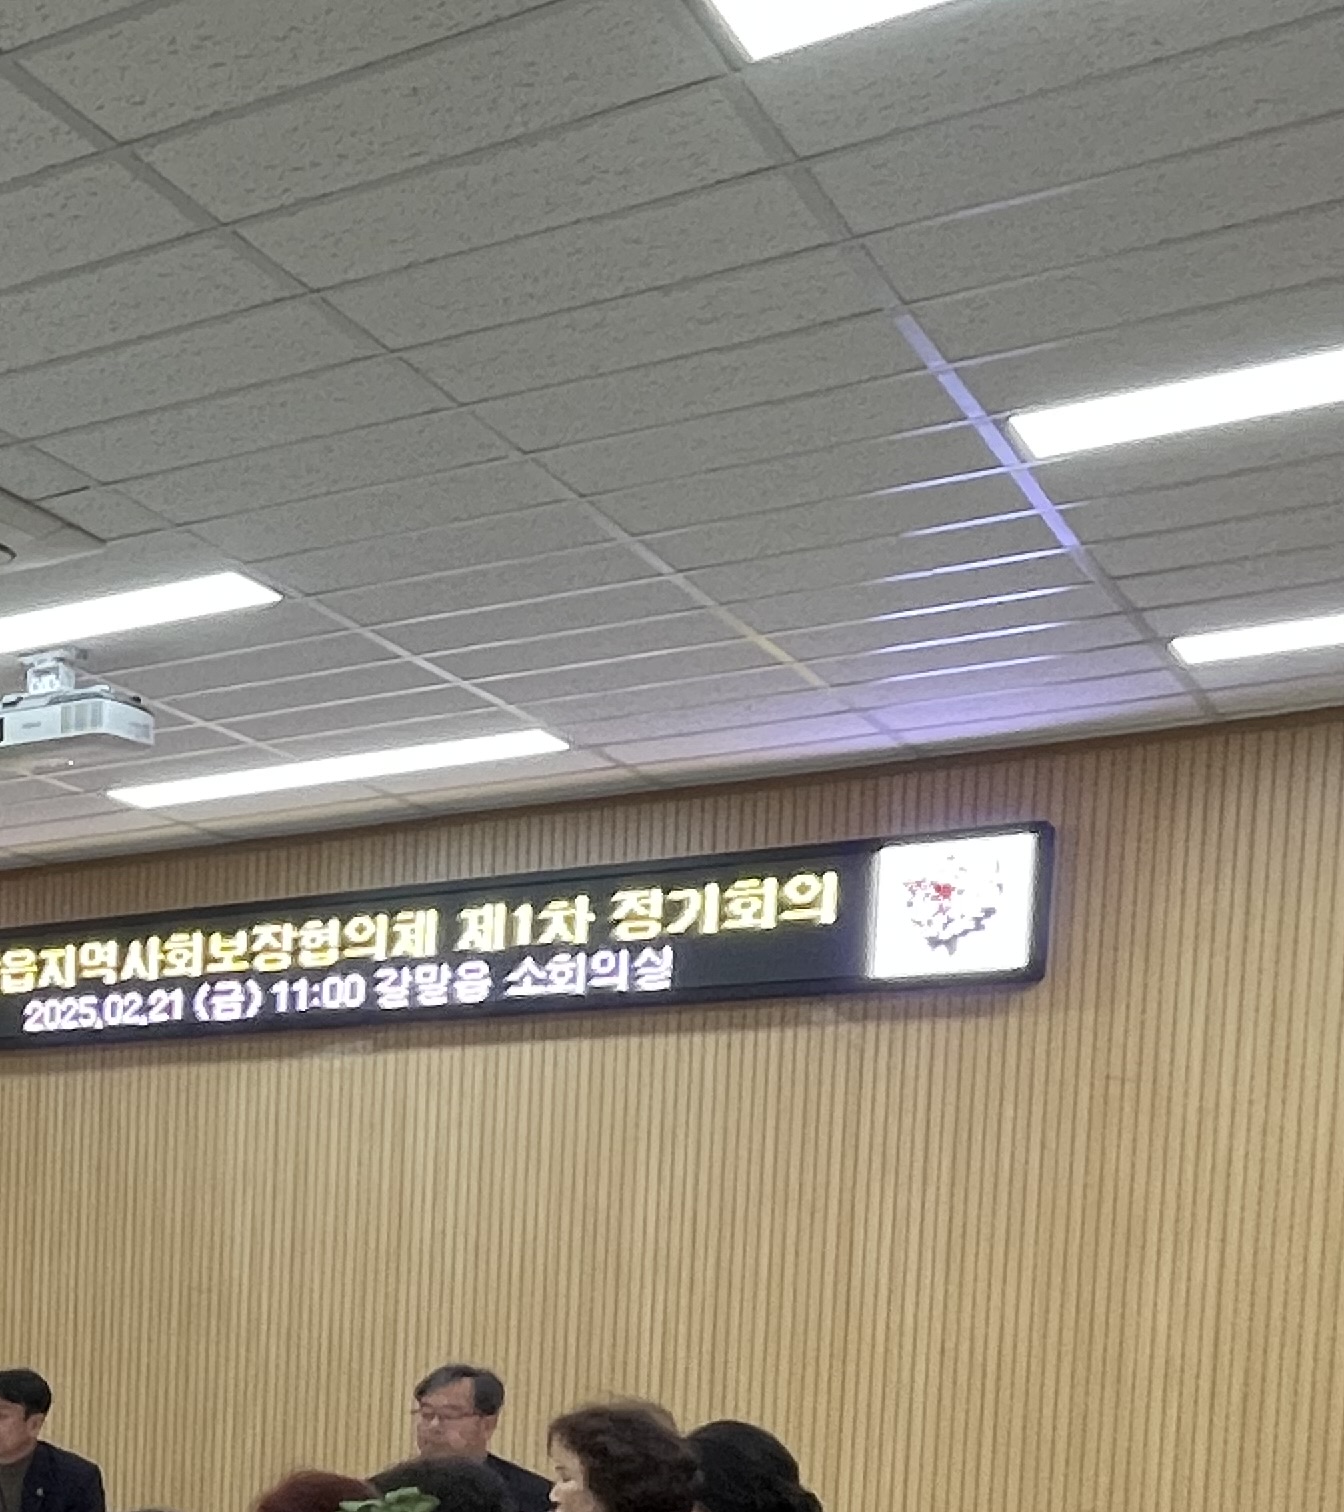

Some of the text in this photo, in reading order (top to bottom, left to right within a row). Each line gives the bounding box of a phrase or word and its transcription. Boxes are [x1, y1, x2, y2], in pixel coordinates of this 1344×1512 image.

[453, 894, 596, 952] 제1차
[610, 870, 838, 942] 정기회의
[23, 944, 674, 1032] 2025.02.21 (금) 11:00 갈말읍 소회의실
